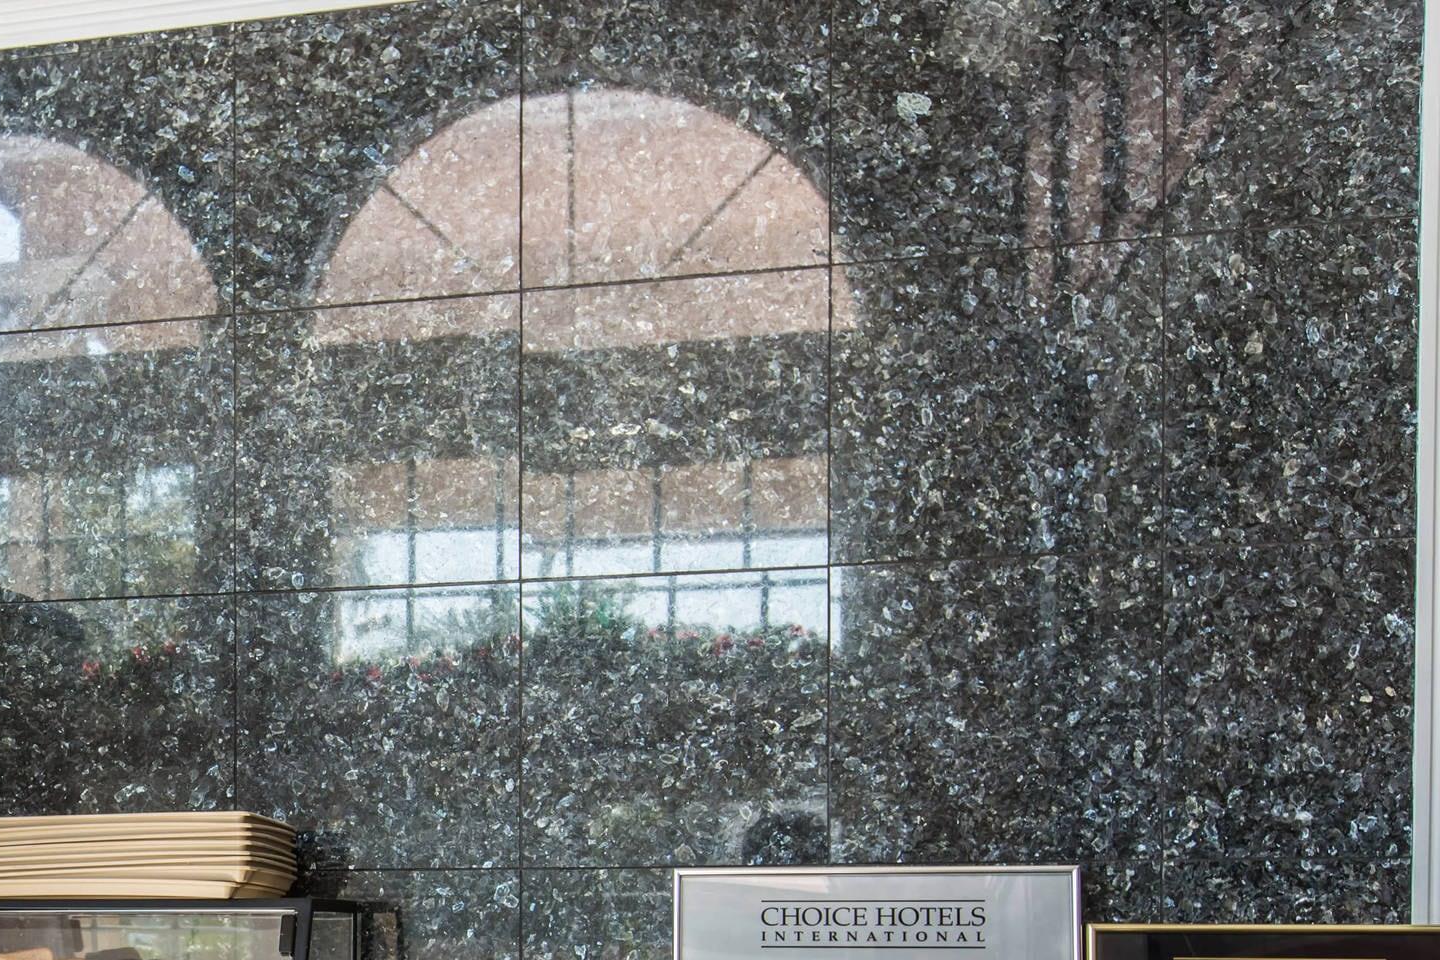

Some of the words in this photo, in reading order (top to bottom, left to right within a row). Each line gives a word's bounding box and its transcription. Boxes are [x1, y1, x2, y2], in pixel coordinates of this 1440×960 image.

[761, 907, 868, 927] CHOICE
[875, 906, 986, 927] HOTELS
[761, 931, 986, 942] INTERNATIONAL
